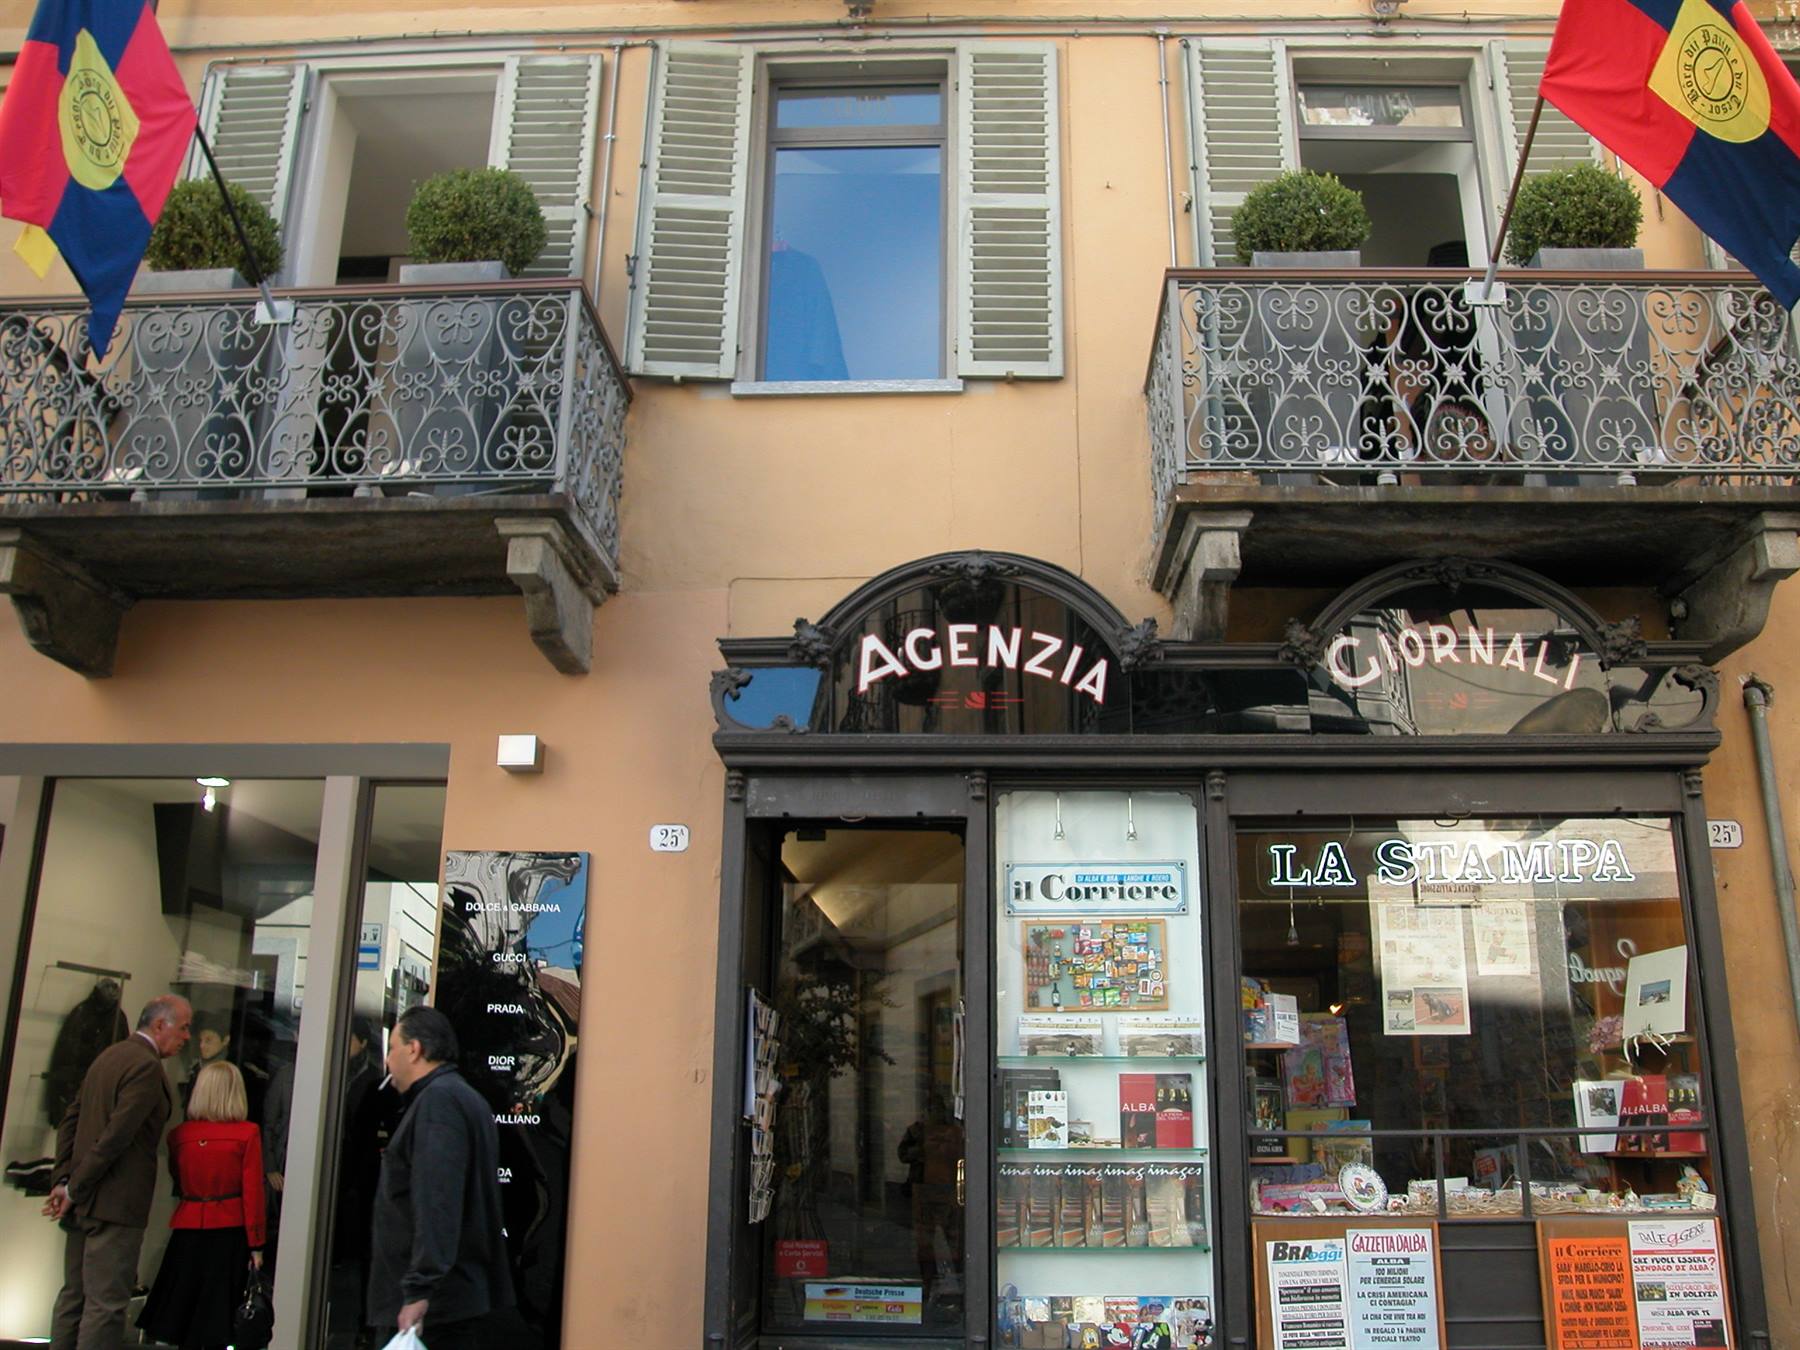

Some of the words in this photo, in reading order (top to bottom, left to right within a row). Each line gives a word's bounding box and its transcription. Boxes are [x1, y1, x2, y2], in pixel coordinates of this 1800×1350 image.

[1326, 623, 1584, 691] GIORNALI
[854, 623, 1110, 705] AGENZIA
[1269, 841, 1357, 888] LA
[1377, 838, 1637, 886] STAMPA
[1014, 881, 1032, 900] il
[1040, 874, 1179, 902] Corriere
[465, 902, 501, 912] DOLCE
[511, 903, 561, 912] GABBANA
[492, 953, 527, 963] GUCCI
[487, 1003, 524, 1014] PRADA
[488, 1055, 515, 1066] DIOR
[1121, 1103, 1156, 1112] ALBA
[1639, 1103, 1668, 1113] ALBA
[492, 1114, 541, 1125] ALLIANO
[1148, 1163, 1202, 1180] images
[1352, 1233, 1396, 1254] GAZZETTA
[1396, 1233, 1428, 1253] D'ALBA
[1566, 1244, 1622, 1257] Corriere
[1360, 1277, 1372, 1285] PER
[1403, 1276, 1425, 1284] SOLARE
[1357, 1291, 1366, 1299] LA
[1367, 1291, 1386, 1299] CRISI
[1387, 1291, 1428, 1299] AMERICANA
[1378, 1299, 1416, 1307] CONTAGIA?
